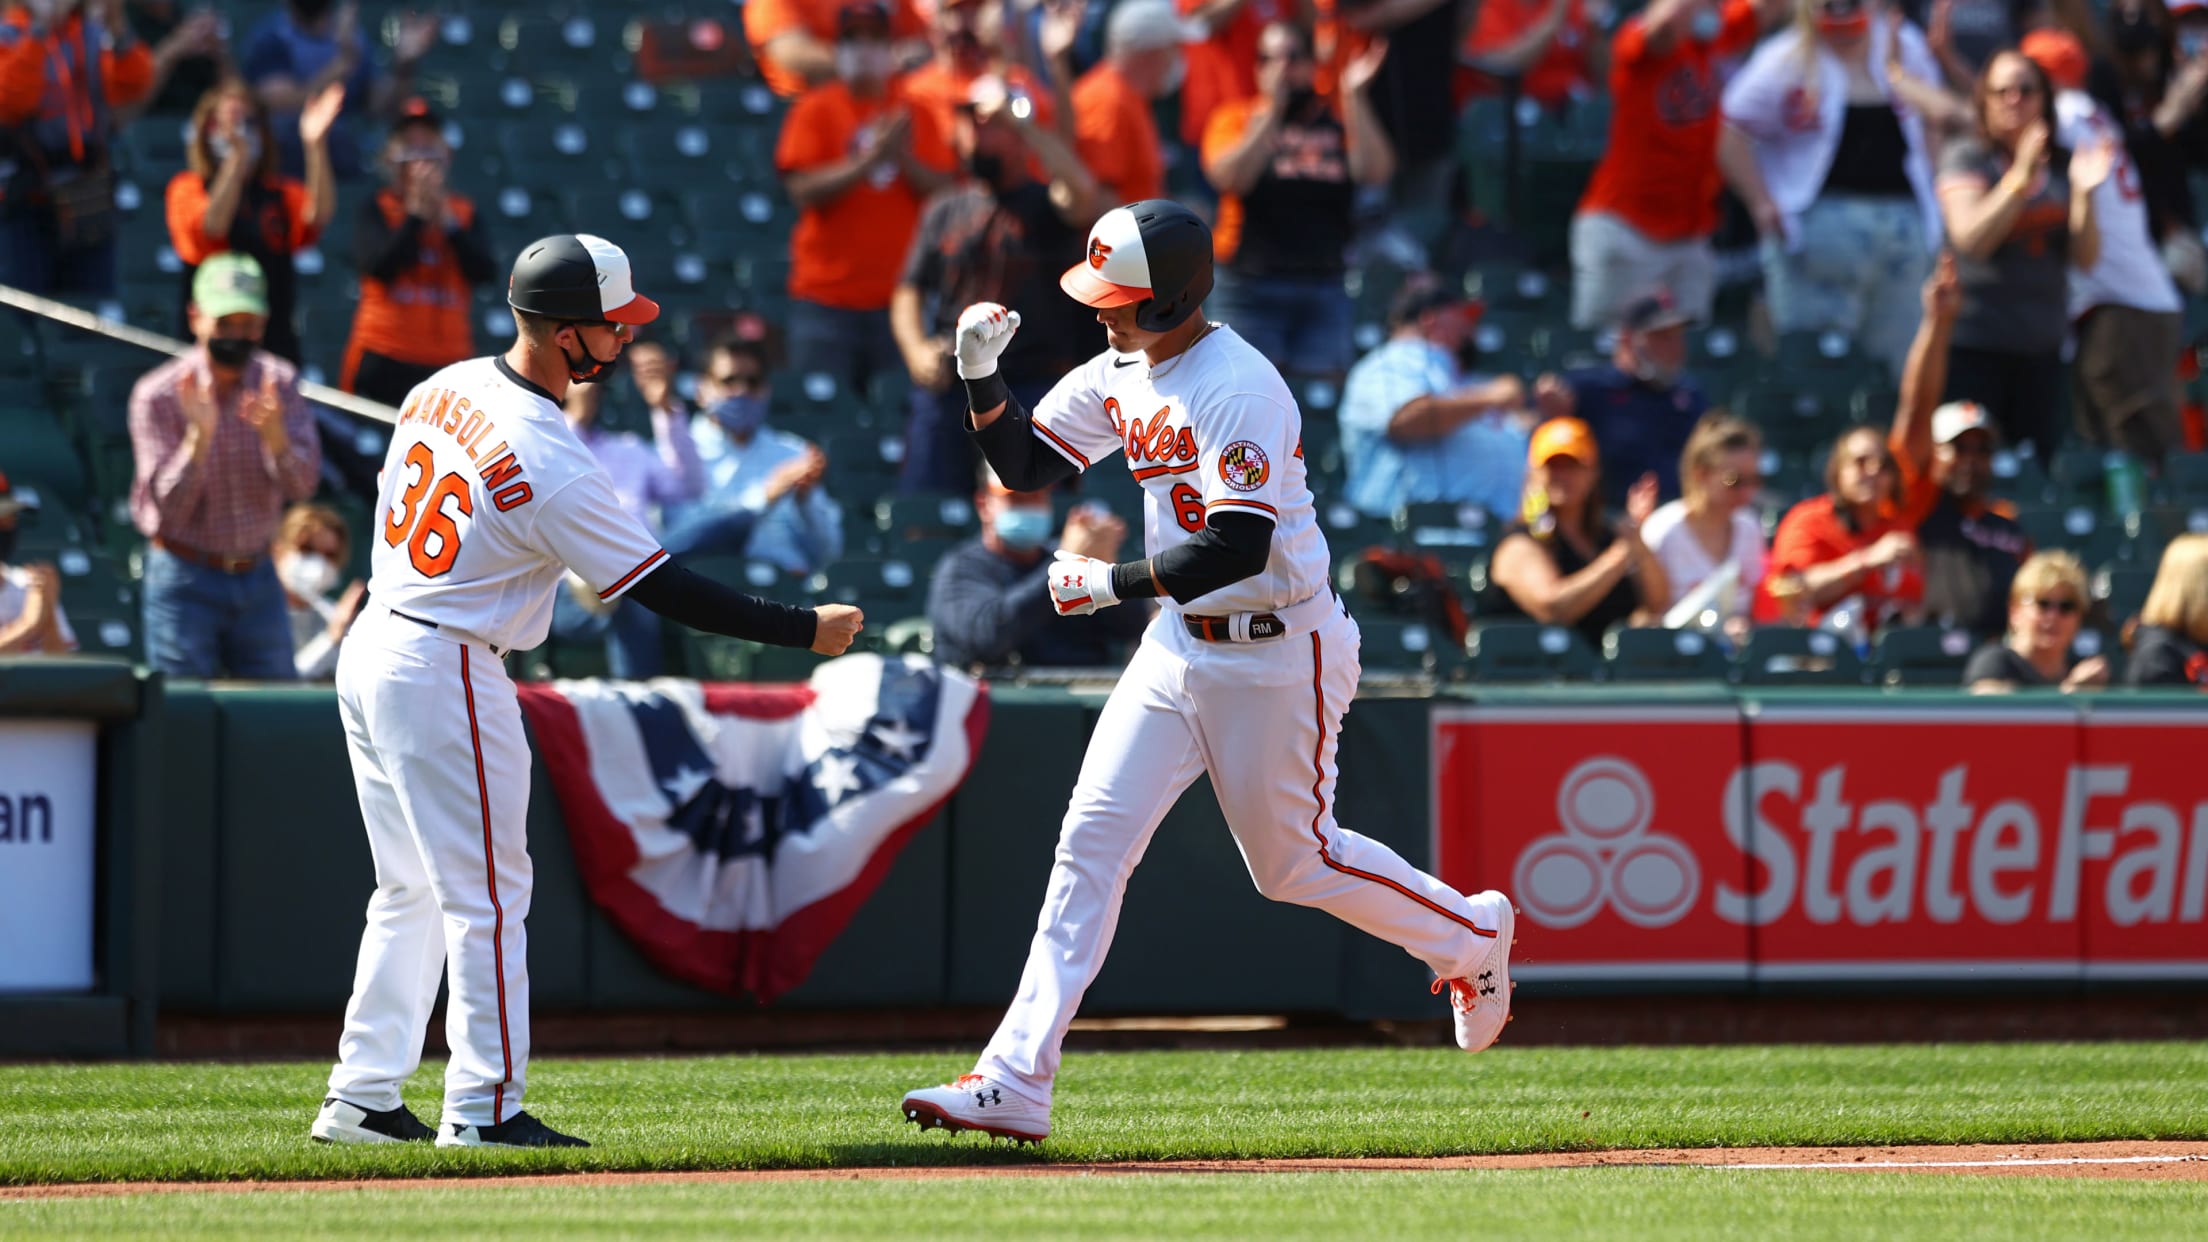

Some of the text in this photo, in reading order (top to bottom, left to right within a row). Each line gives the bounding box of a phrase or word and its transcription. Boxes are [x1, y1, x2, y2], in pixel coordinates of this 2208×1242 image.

[399, 387, 534, 513] MANSOLINO
[1223, 441, 1267, 462] BALTIMORE
[1224, 478, 1262, 491] ORIOLES
[384, 440, 474, 579] 36
[1170, 482, 1207, 534] 6
[1252, 622, 1272, 635] RM
